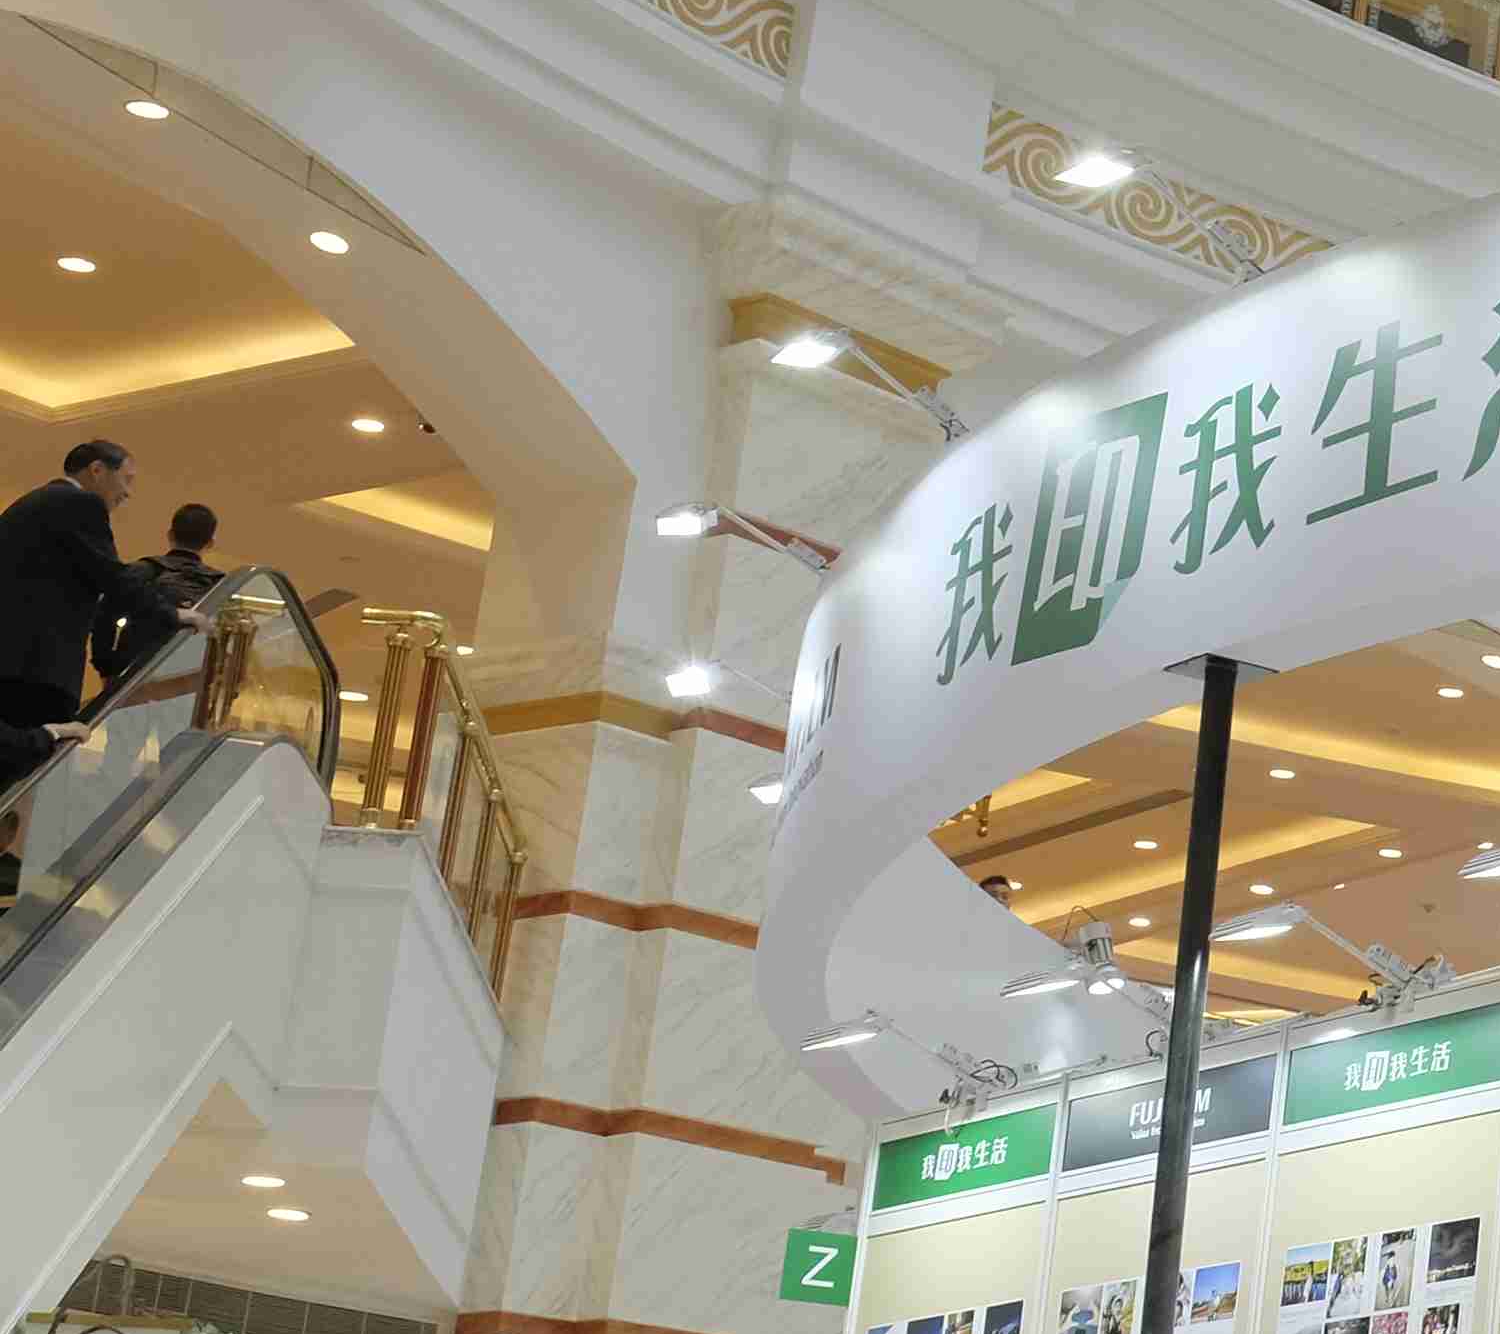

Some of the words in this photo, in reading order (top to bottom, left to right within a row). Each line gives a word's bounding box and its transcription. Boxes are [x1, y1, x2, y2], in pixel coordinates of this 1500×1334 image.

[1344, 1040, 1453, 1092] 我印我生活
[1129, 1087, 1212, 1127] FUJM
[921, 1136, 1009, 1181] 我印我生活
[800, 1245, 839, 1288] Z
